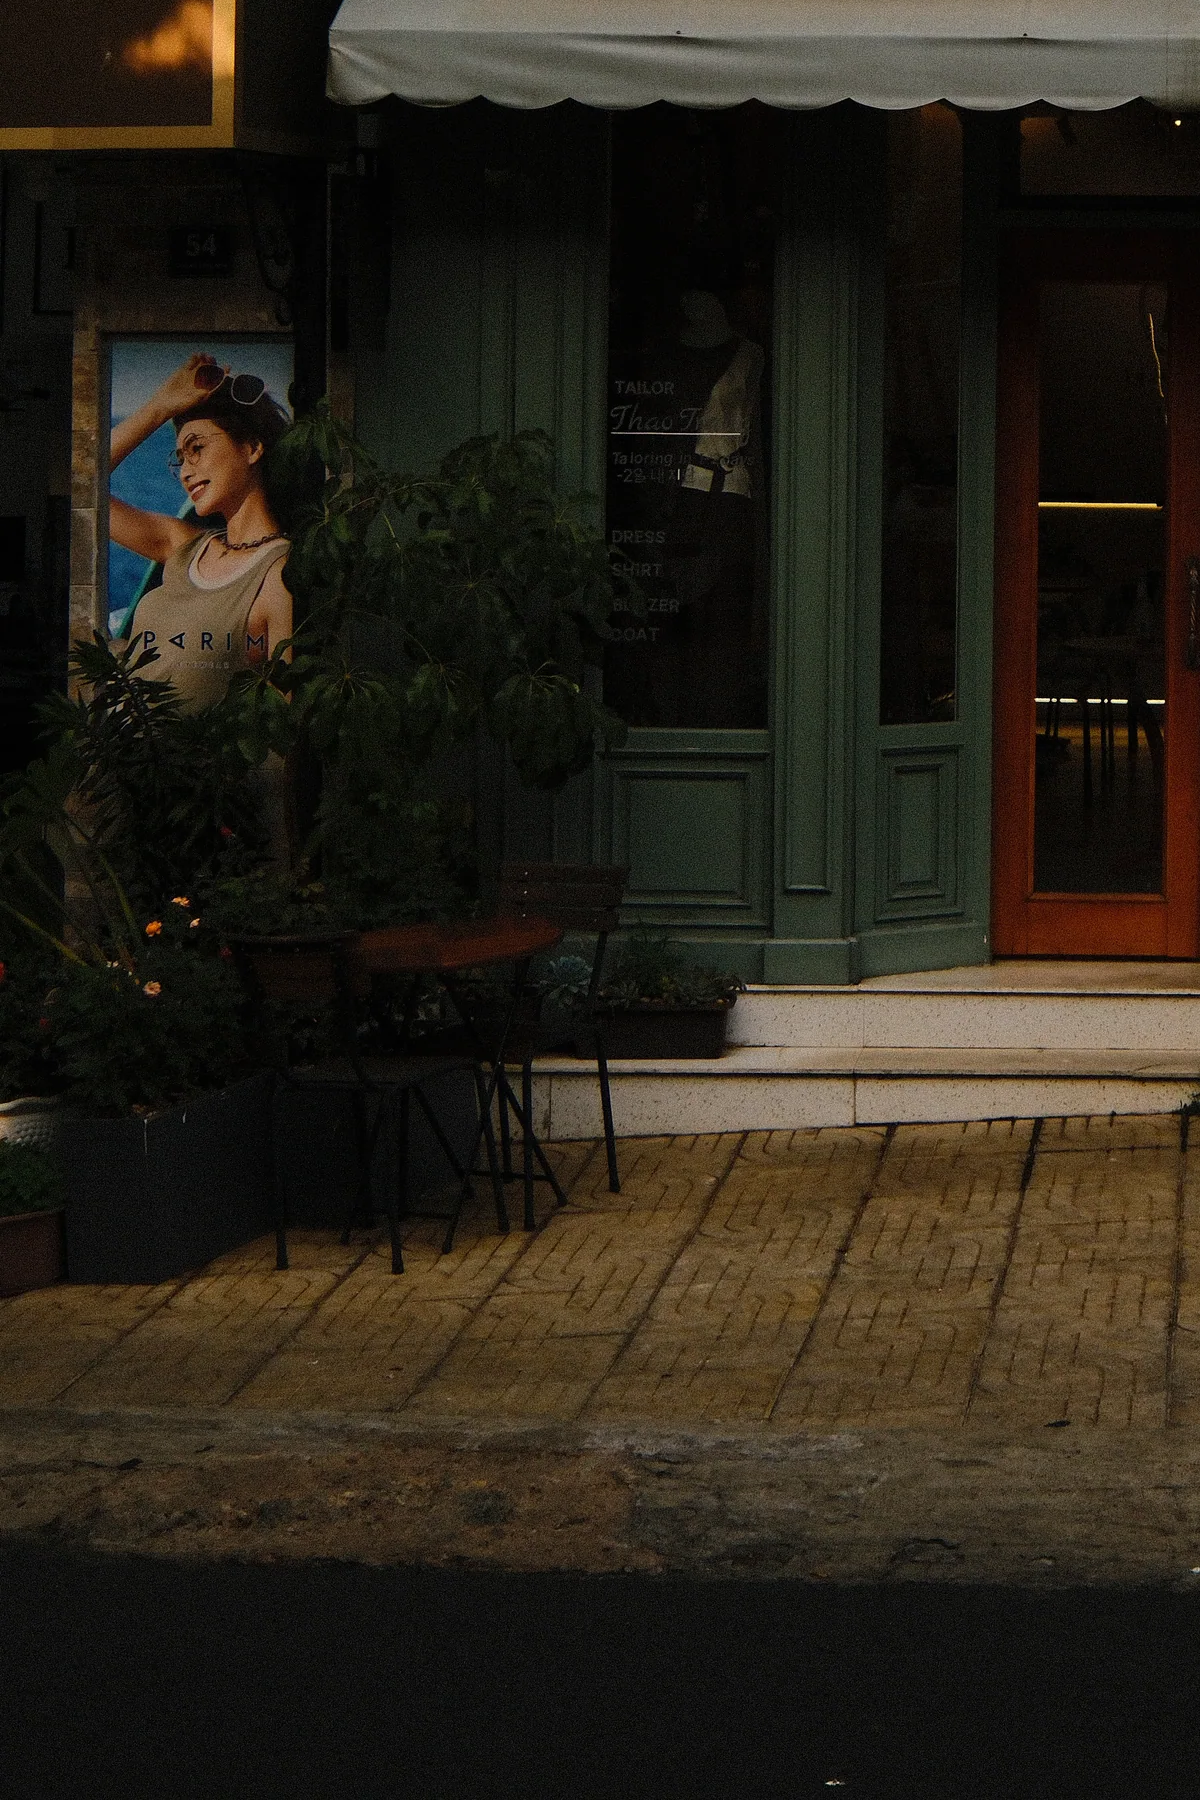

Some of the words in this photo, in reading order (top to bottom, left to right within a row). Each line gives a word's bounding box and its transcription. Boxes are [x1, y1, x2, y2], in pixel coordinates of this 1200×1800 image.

[615, 380, 675, 396] TAILOR
[679, 407, 752, 447] Trg
[611, 529, 667, 545] DRESS
[611, 562, 663, 578] SHIRT
[612, 597, 681, 613] BLZER
[610, 626, 661, 642] COAT
